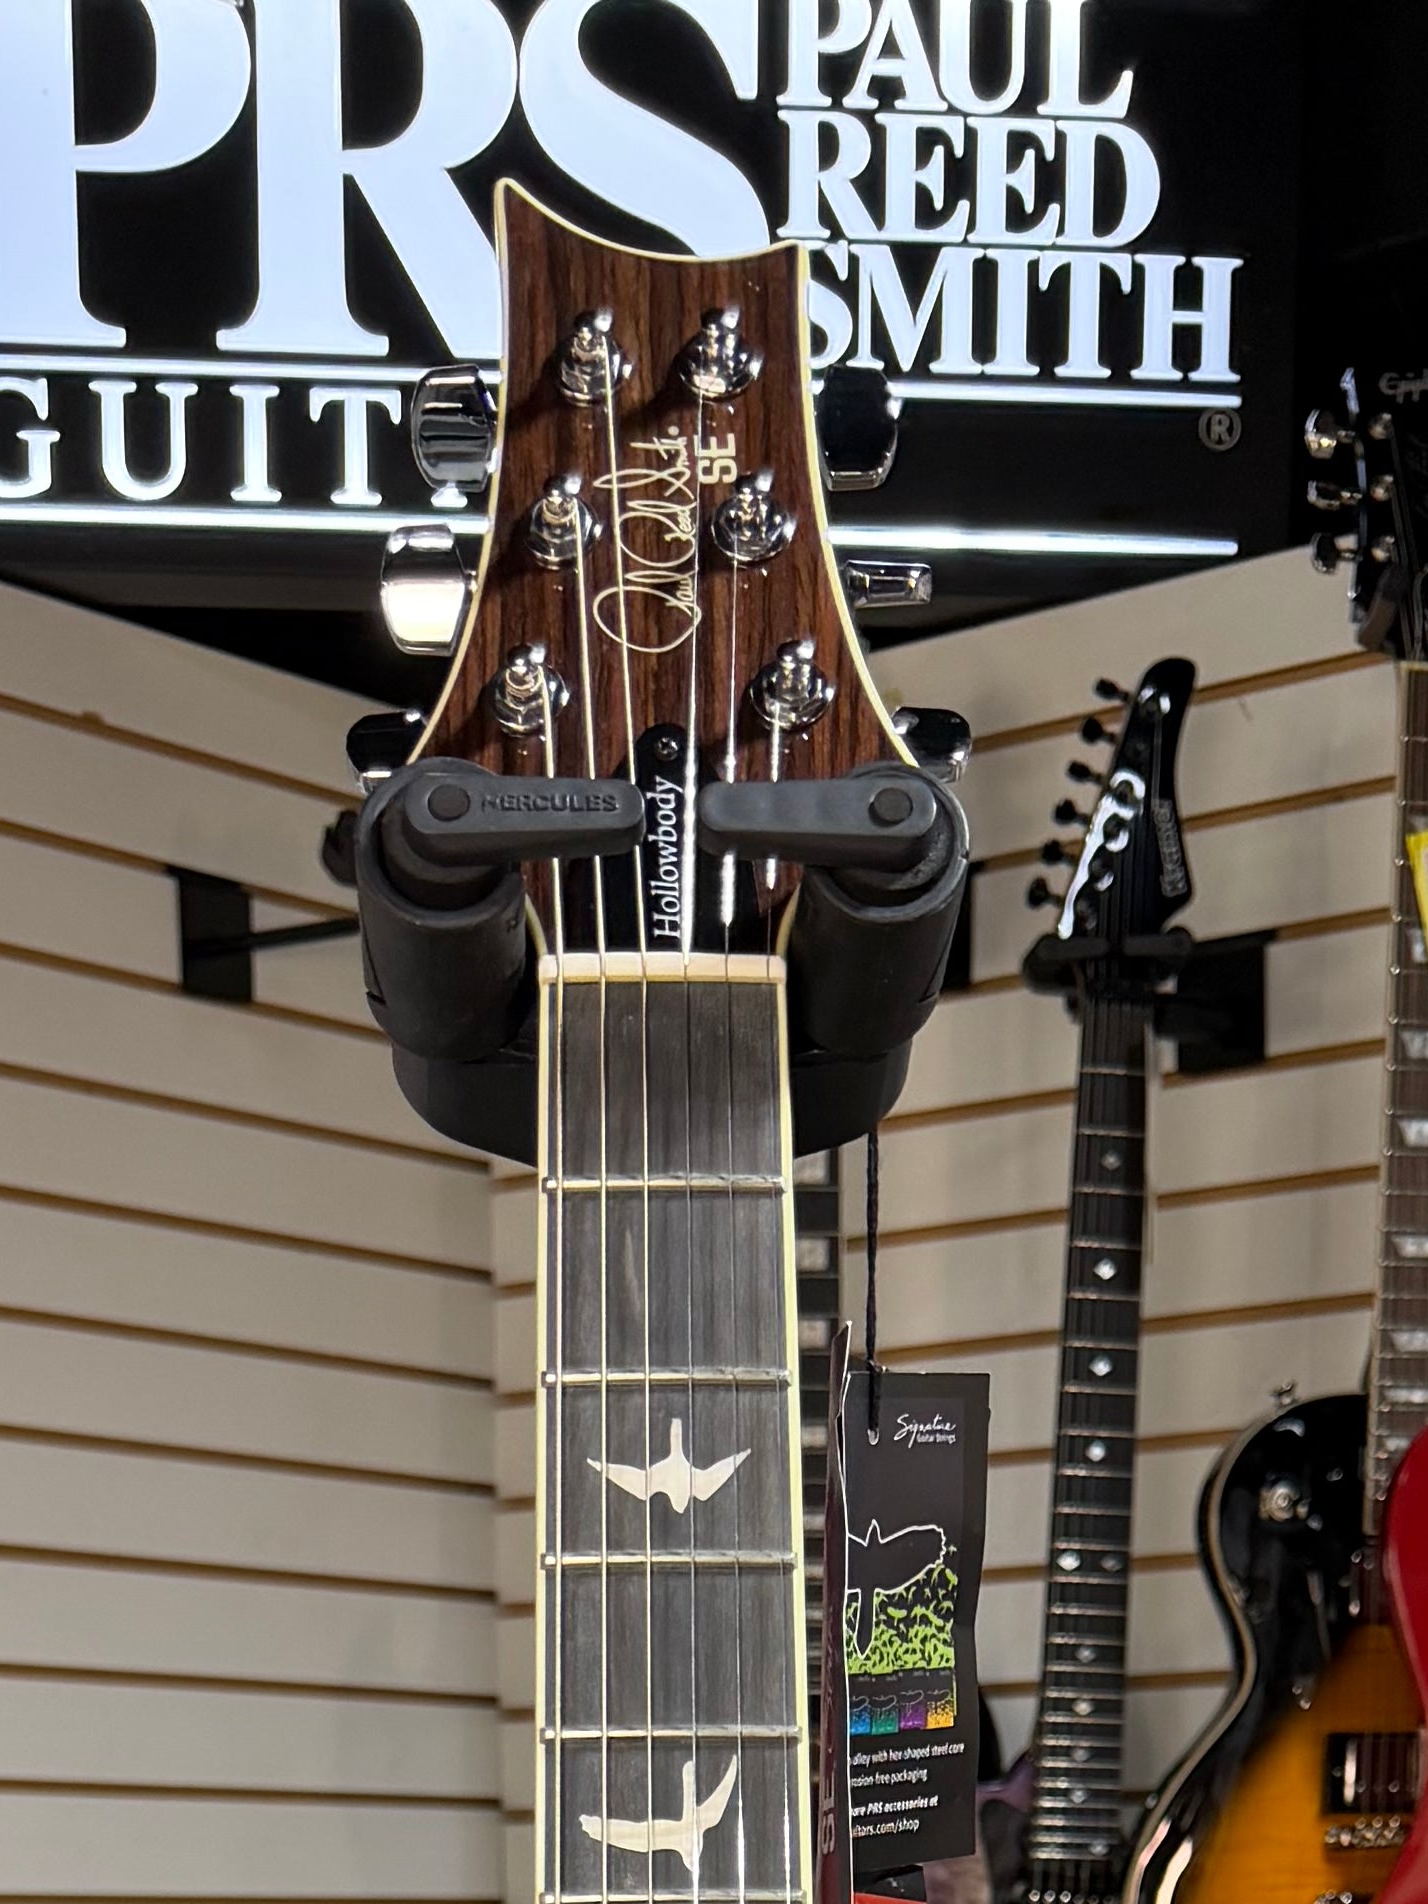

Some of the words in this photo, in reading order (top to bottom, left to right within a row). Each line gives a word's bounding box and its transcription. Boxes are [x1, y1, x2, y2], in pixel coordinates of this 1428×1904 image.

[776, 0, 1134, 118] PAUL
[779, 111, 1162, 247] REED
[806, 243, 1243, 382] SMITH
[693, 432, 738, 485] SE
[481, 794, 621, 813] HERCULES
[652, 776, 685, 940] Hollowbody
[867, 1802, 883, 1816] PRS
